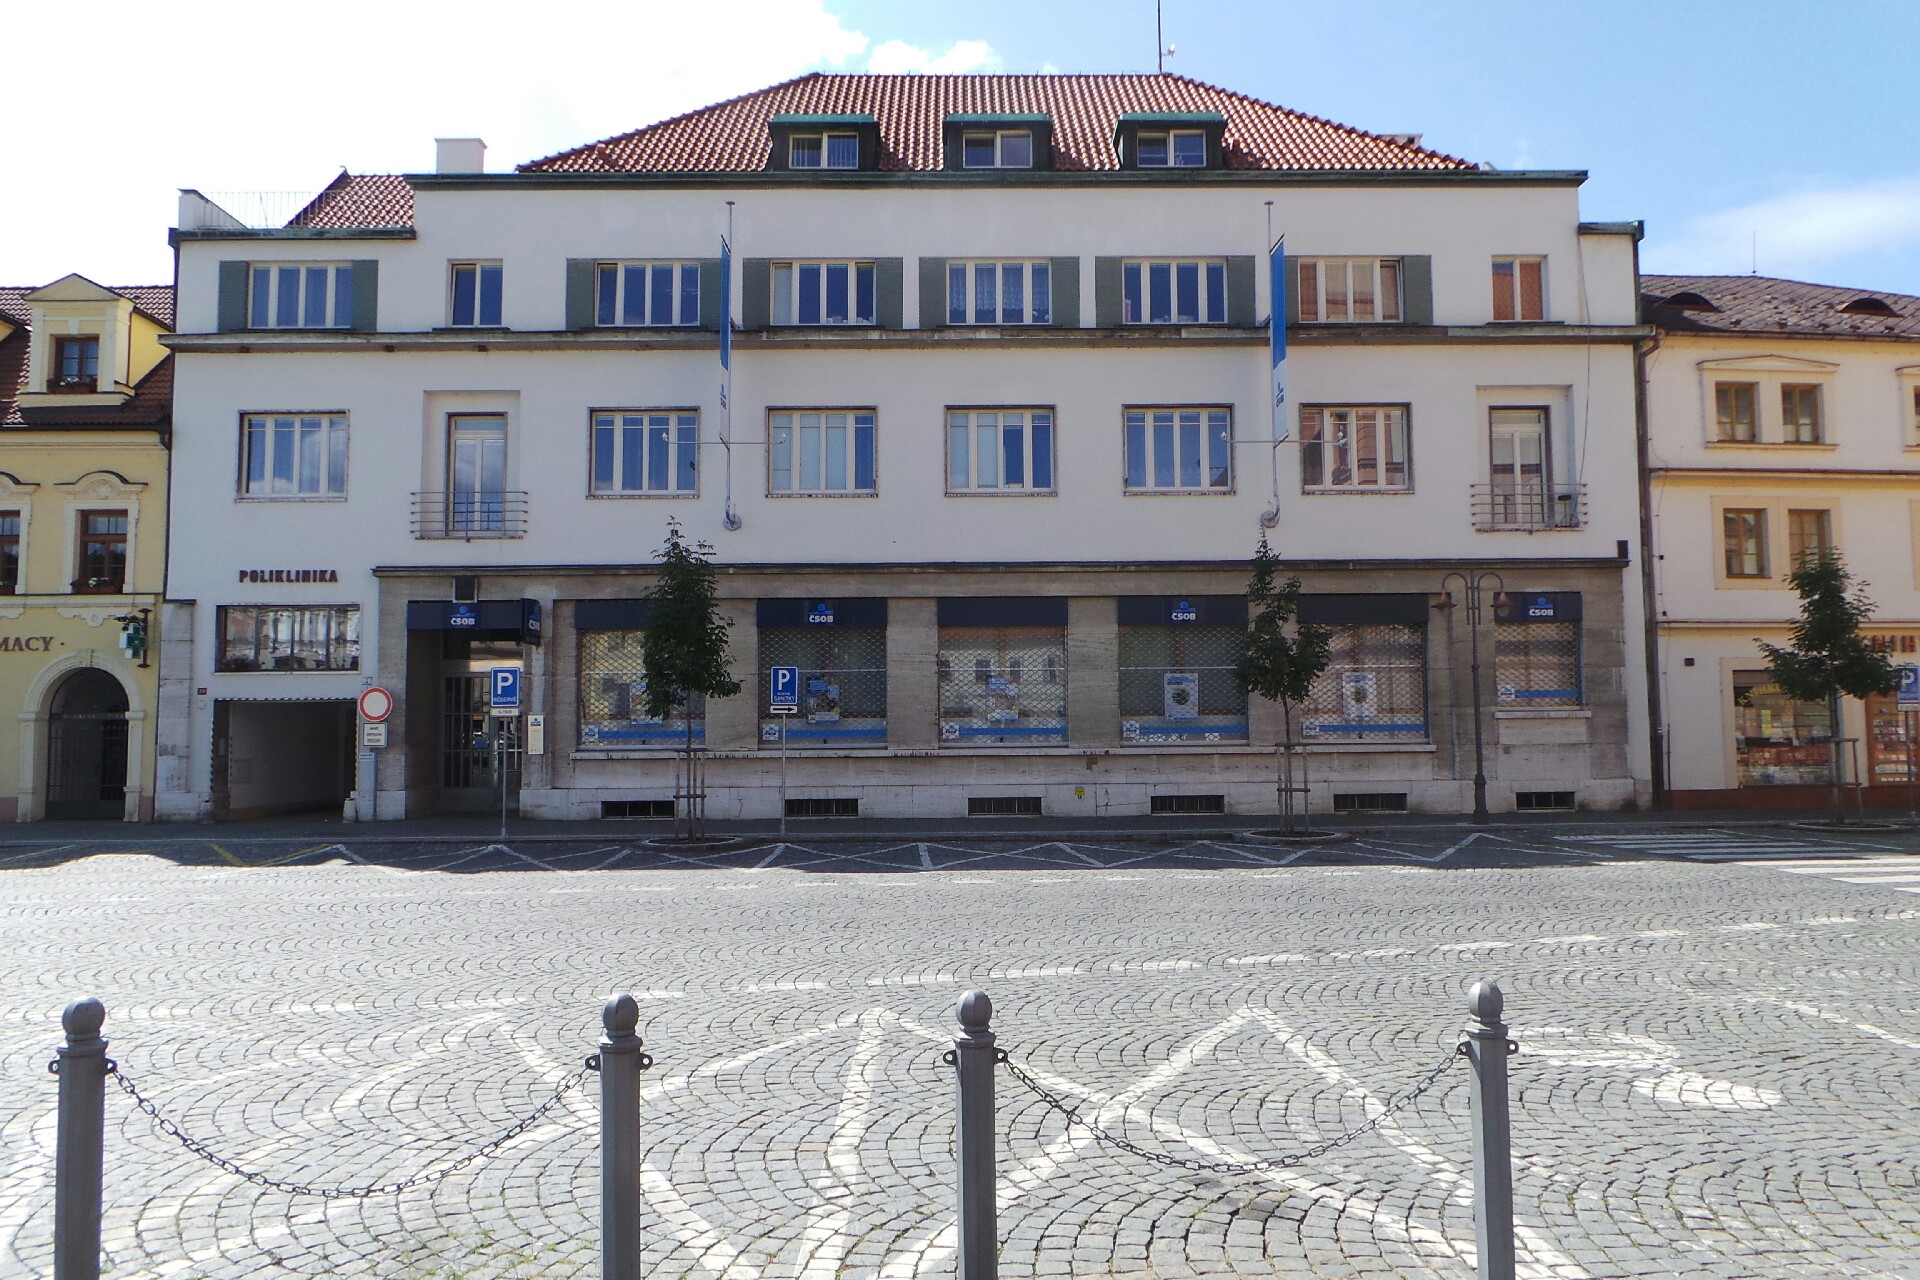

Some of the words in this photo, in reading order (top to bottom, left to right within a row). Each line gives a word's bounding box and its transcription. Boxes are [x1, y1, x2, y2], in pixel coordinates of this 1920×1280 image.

[239, 569, 338, 583] POLIKLINIKA
[497, 672, 514, 695] P
[778, 669, 790, 691] P
